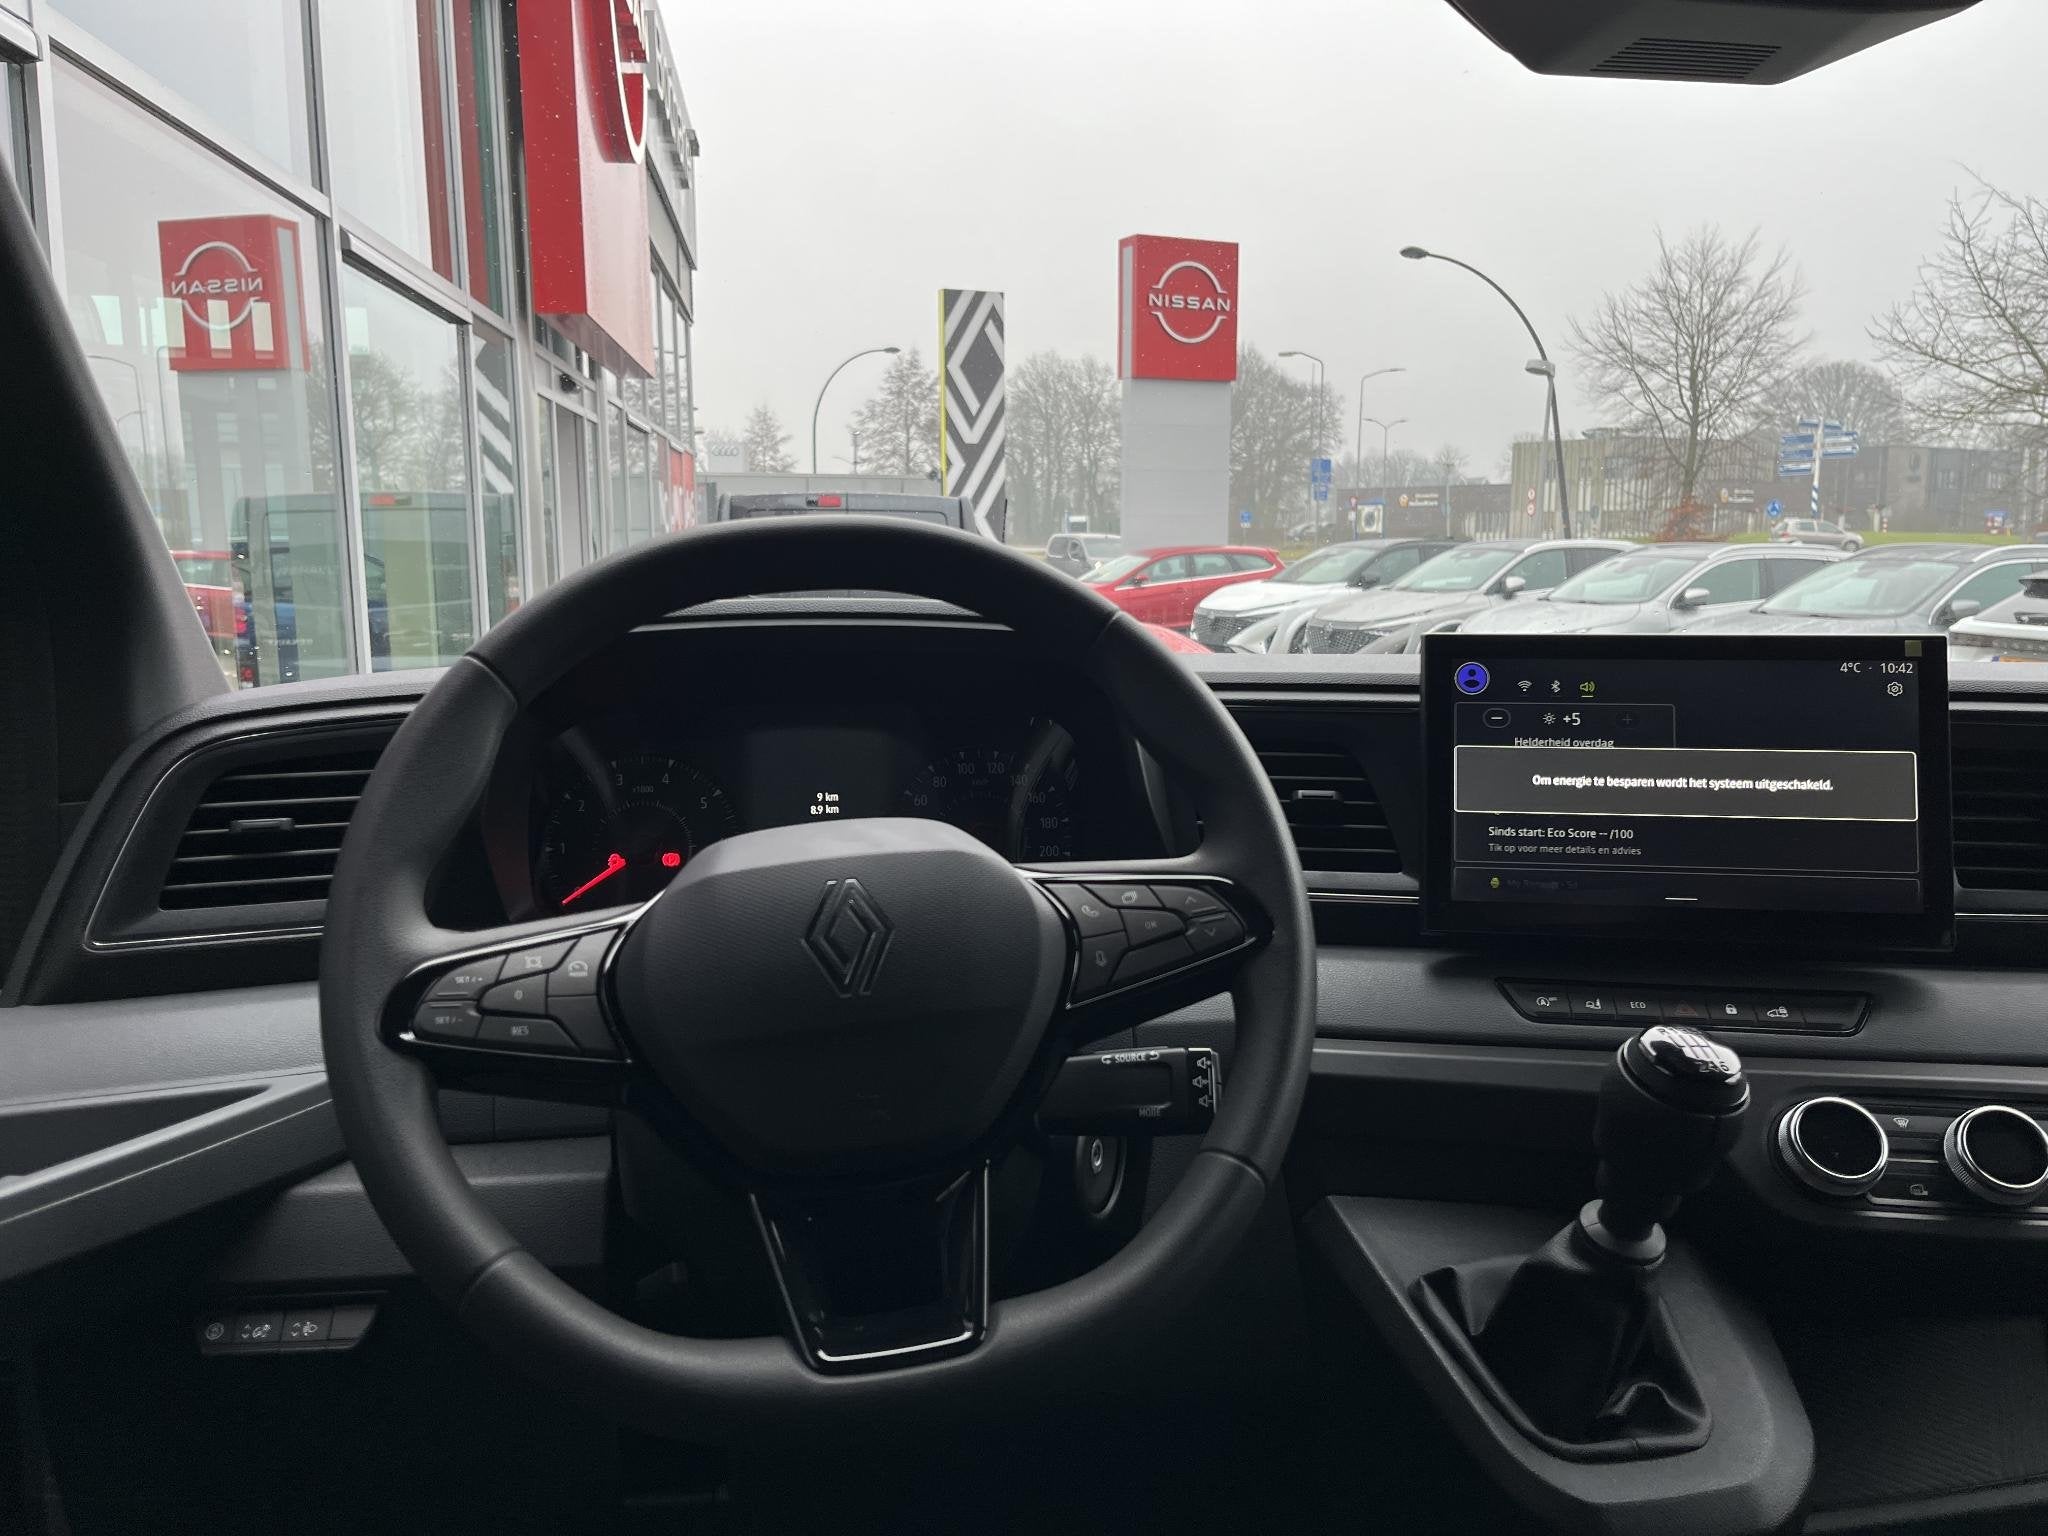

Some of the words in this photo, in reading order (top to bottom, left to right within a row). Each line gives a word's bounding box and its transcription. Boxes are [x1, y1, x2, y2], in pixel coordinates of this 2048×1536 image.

[1148, 293, 1231, 311] NISSAN
[1840, 662, 1861, 673] 4°C
[1880, 662, 1913, 674] 10:42
[1563, 712, 1581, 726] +5
[1514, 737, 1571, 747] Helderheid
[1572, 738, 1615, 749] overdag
[958, 763, 975, 775] 100
[987, 763, 1005, 774] 120
[615, 774, 623, 786] 3
[662, 773, 672, 784] 4
[932, 776, 947, 788] 80
[1532, 774, 1551, 786] Om
[1552, 775, 1593, 789] energie
[1593, 776, 1605, 787] te
[1606, 775, 1655, 789] besparen
[1656, 777, 1688, 788] wordt
[1689, 777, 1707, 789] het
[1708, 778, 1753, 791] systeem
[1754, 779, 1834, 792] uitgeschakeld.
[699, 797, 708, 809] 5
[816, 792, 823, 802] 9
[825, 792, 839, 802] km
[914, 795, 928, 806] 60
[576, 800, 585, 812] 2
[810, 805, 823, 815] 8.9
[825, 804, 839, 814] km
[1040, 818, 1058, 829] 180
[1488, 826, 1516, 836] Sinds
[1518, 827, 1545, 837] start:
[1547, 828, 1565, 838] Eco
[1567, 828, 1597, 838] Score
[1610, 829, 1634, 839] /100
[560, 843, 566, 855] 1
[1040, 845, 1059, 857] 200
[1488, 843, 1502, 852] Tik
[1504, 845, 1516, 854] op
[1565, 844, 1596, 855] details
[1611, 846, 1642, 856] advies
[1630, 1001, 1646, 1009] ECO
[1115, 1053, 1146, 1063] SOURCE
